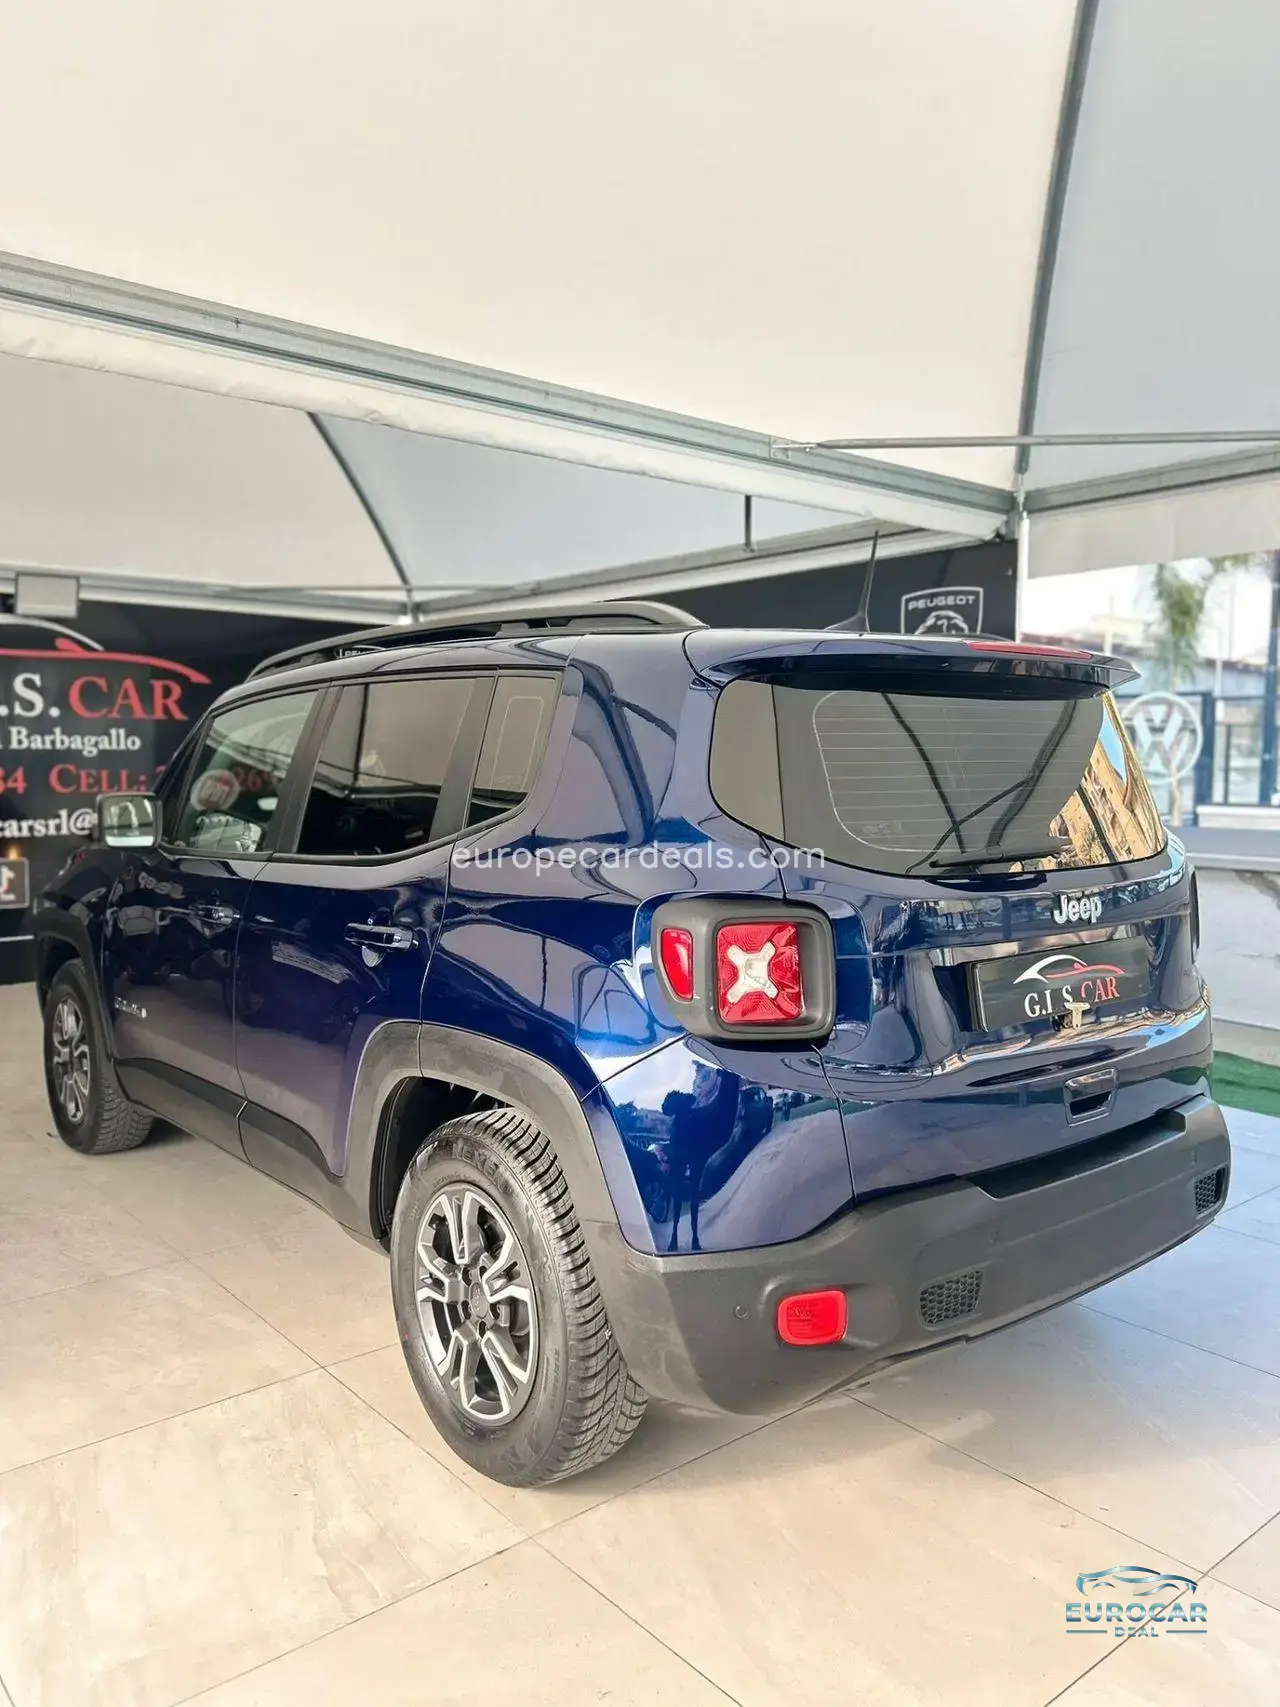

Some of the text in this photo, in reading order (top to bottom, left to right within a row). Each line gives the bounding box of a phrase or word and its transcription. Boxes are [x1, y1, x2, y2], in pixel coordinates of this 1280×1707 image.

[907, 594, 976, 611] PEUGEOT
[68, 675, 189, 721] CAR
[8, 726, 142, 758] Barbagallo
[1053, 894, 1103, 924] Jeep
[1081, 976, 1121, 1003] CAR
